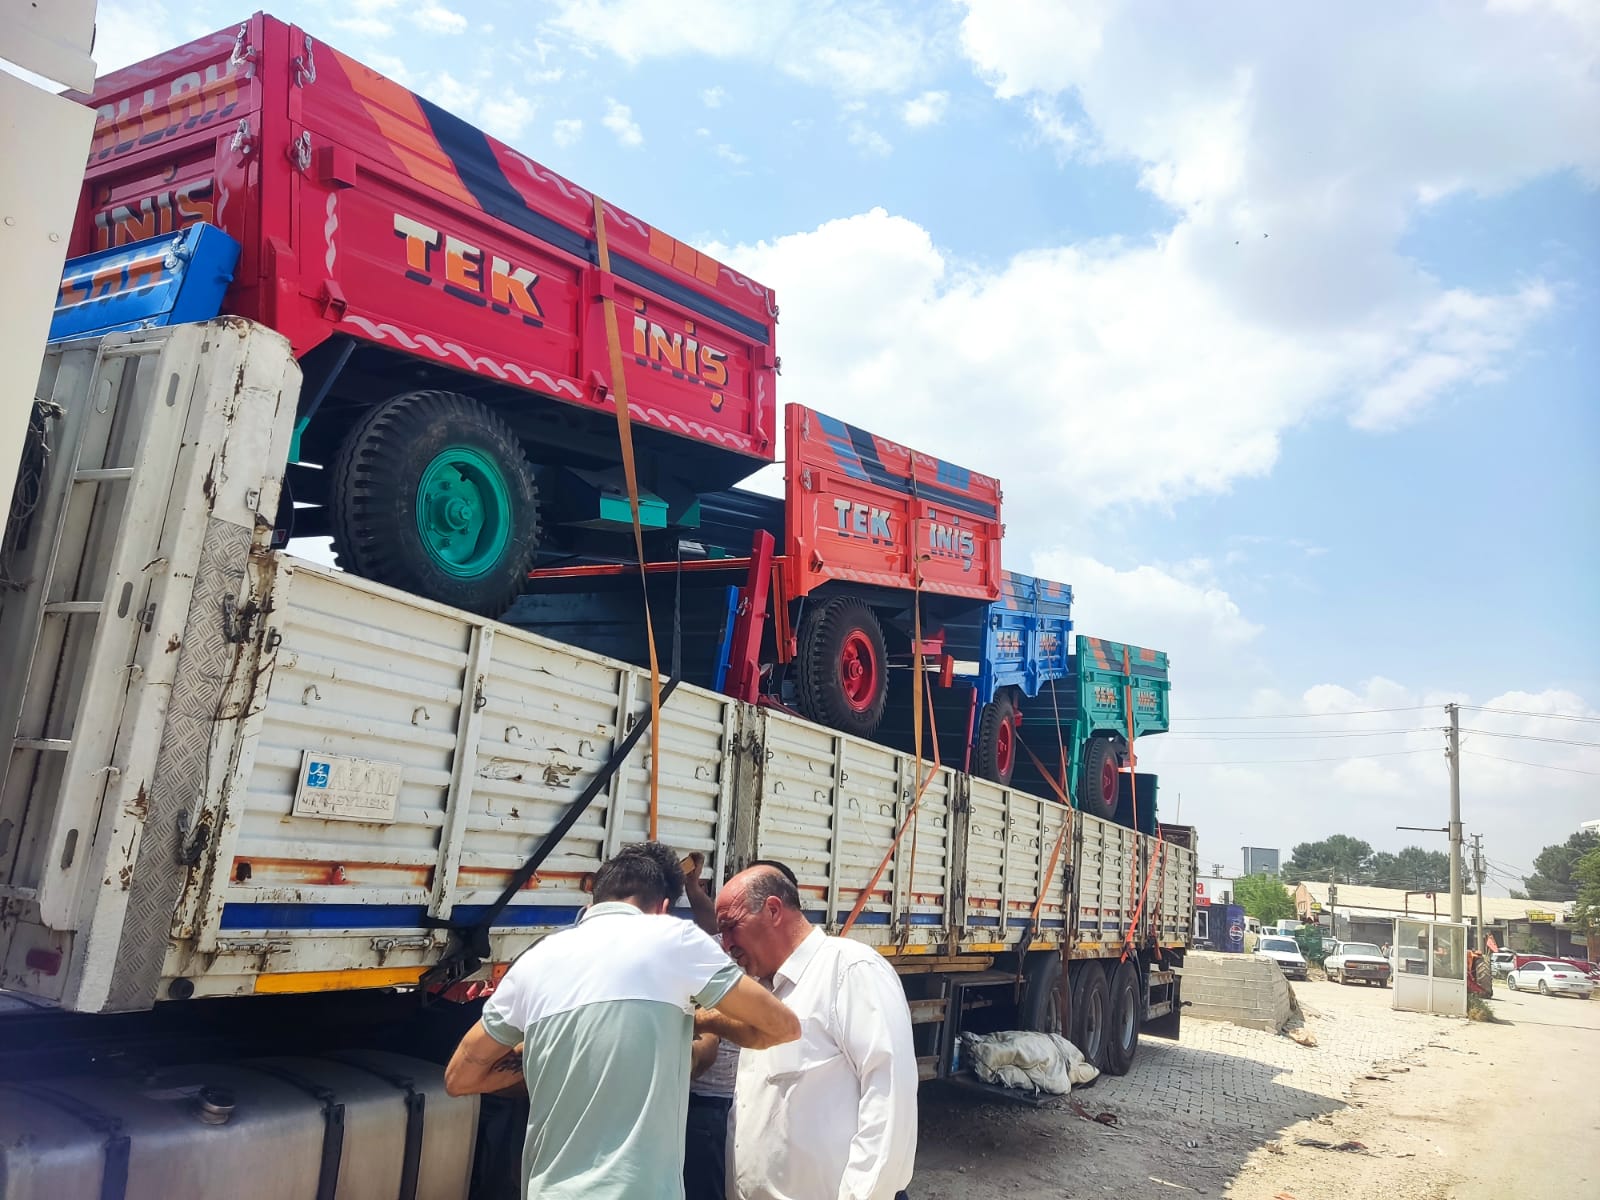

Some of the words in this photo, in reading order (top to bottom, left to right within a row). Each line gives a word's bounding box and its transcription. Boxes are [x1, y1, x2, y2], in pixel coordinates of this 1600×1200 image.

[394, 213, 544, 320] TEK
[633, 297, 729, 411] İNİŞ
[834, 499, 892, 540] TEK
